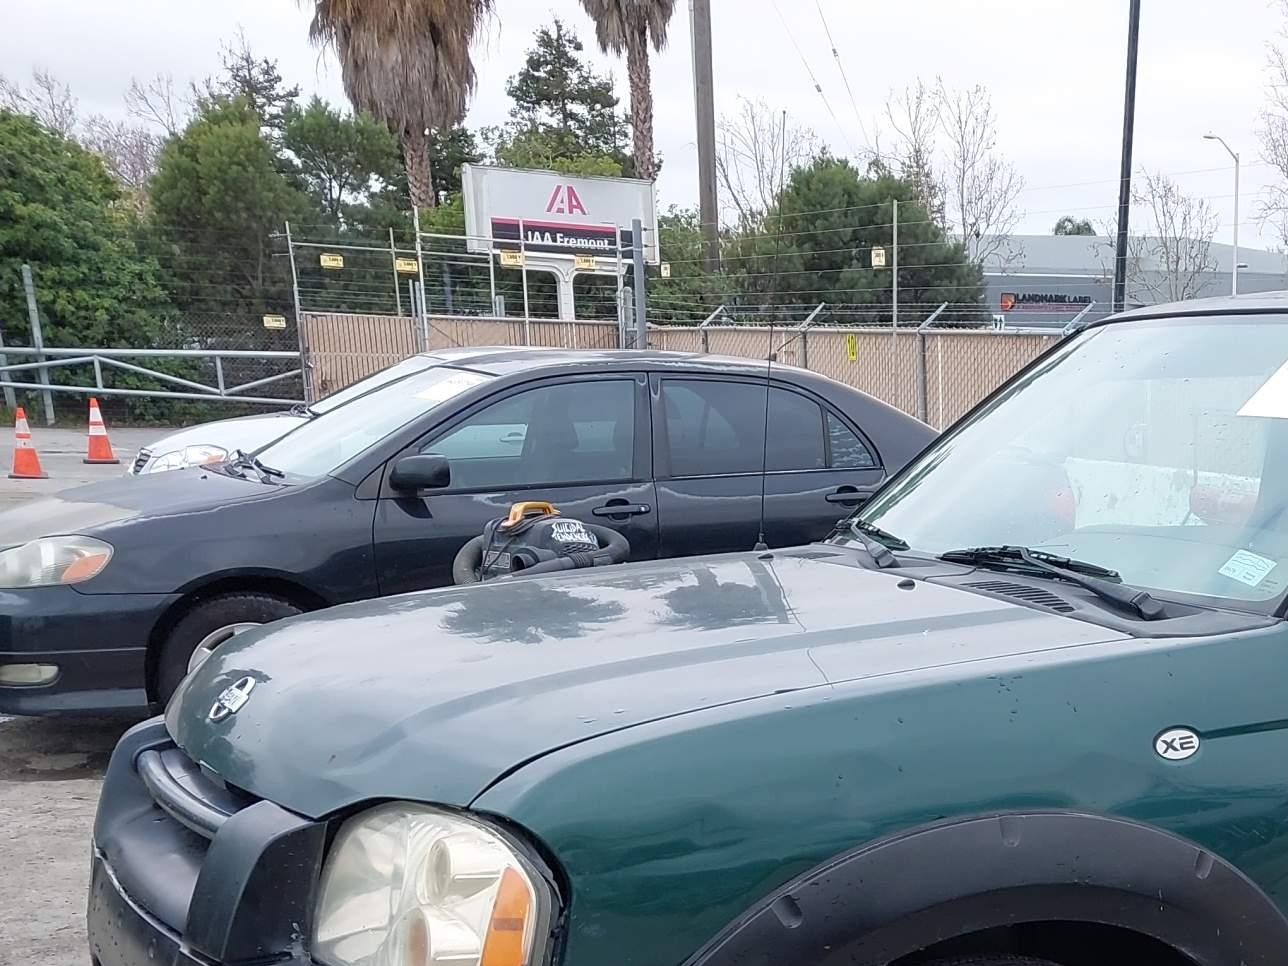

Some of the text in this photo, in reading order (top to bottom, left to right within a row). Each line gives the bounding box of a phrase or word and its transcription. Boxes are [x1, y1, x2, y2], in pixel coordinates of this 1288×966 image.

[527, 230, 609, 250] IAA Fremont
[1016, 293, 1092, 304] LANDMARK LABEL
[551, 521, 586, 538] SUICIDAL
[1160, 735, 1195, 754] XE
